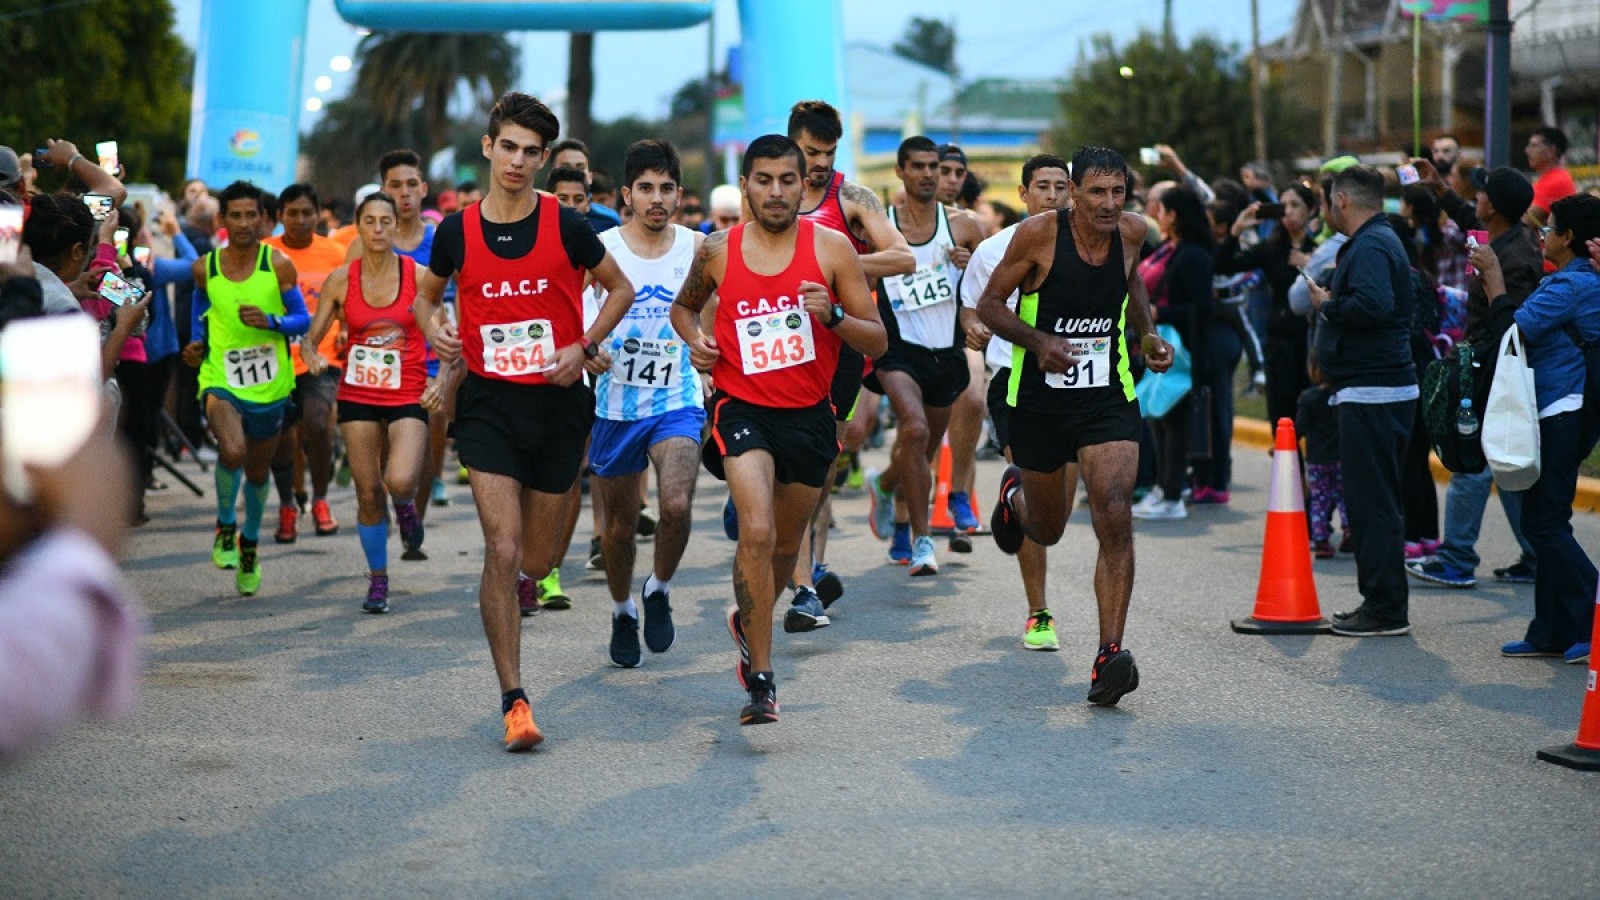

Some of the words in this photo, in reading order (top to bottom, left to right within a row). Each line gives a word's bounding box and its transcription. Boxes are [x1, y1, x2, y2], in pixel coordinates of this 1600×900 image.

[482, 279, 549, 298] C.A.C.F
[908, 276, 952, 306] 145
[1054, 317, 1113, 334] LUCHO
[493, 343, 546, 373] 564
[750, 334, 805, 370] 543
[233, 359, 272, 386] 111
[354, 363, 393, 388] 562
[623, 357, 673, 386] 141
[1063, 359, 1094, 386] 91
